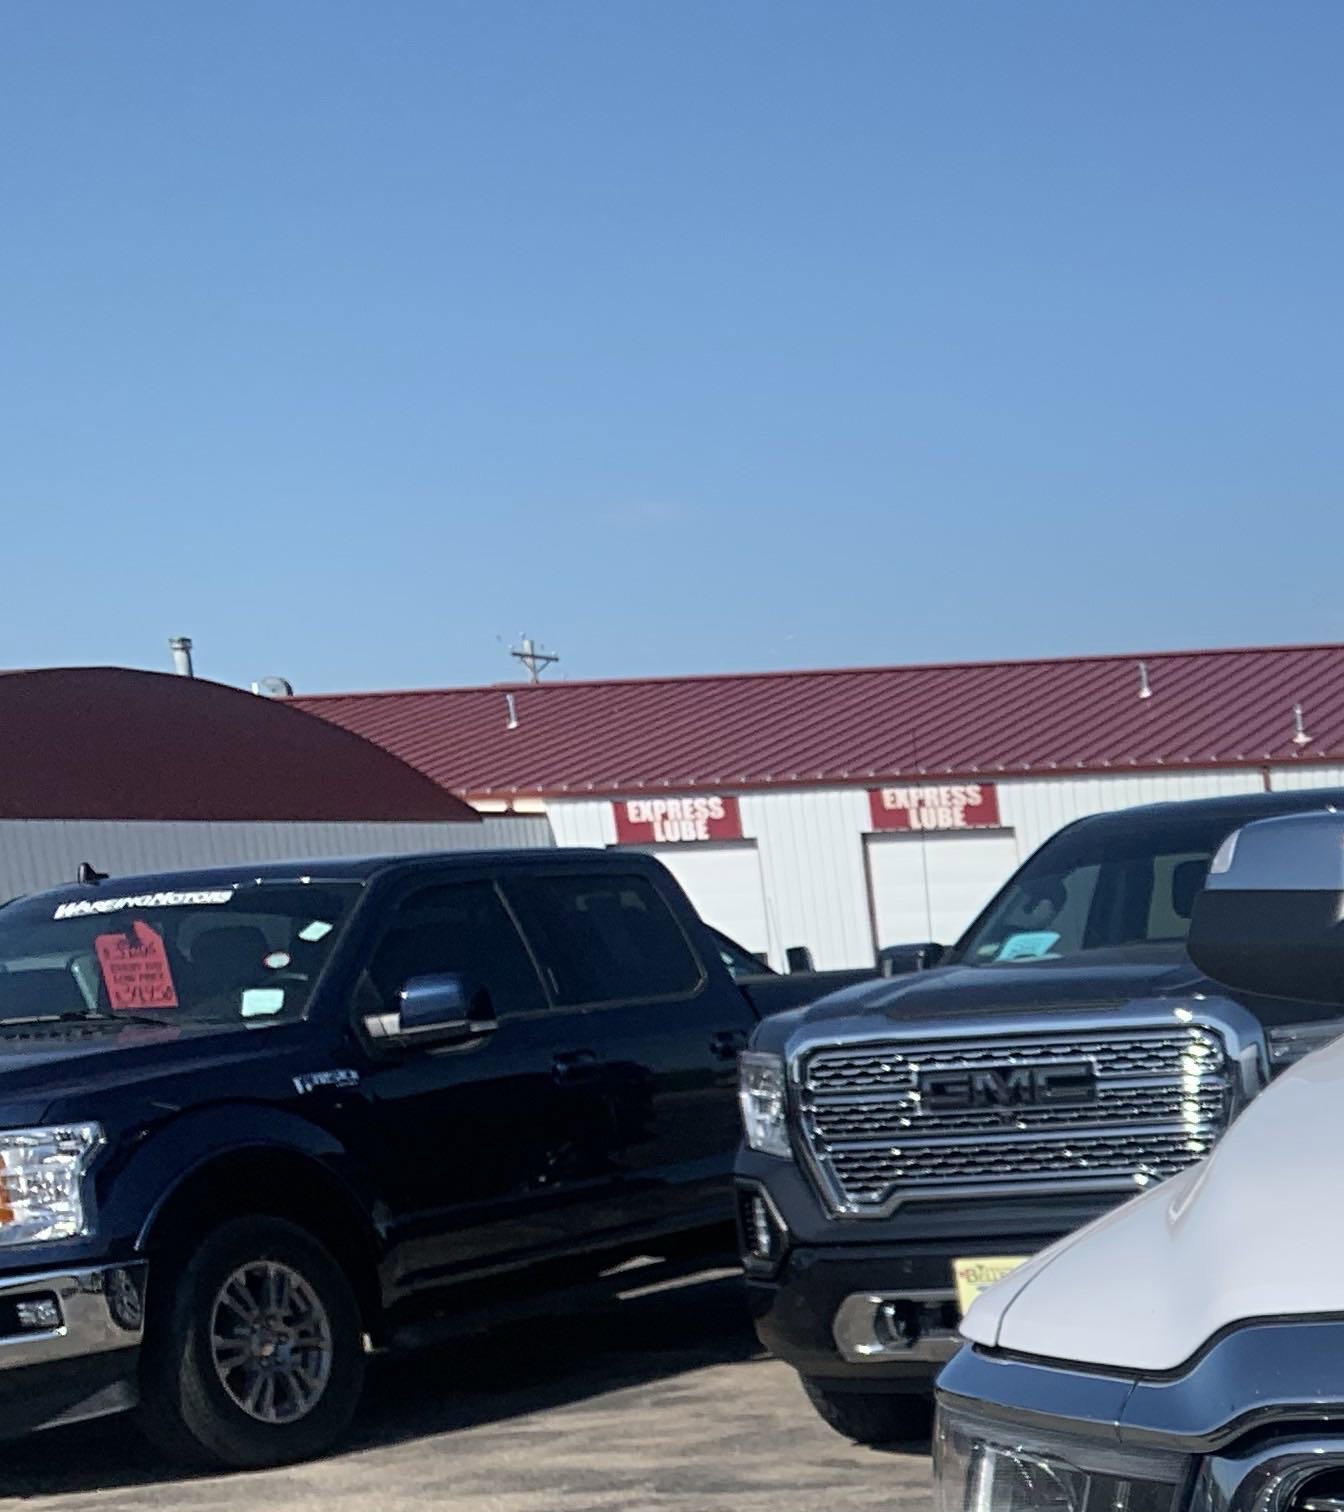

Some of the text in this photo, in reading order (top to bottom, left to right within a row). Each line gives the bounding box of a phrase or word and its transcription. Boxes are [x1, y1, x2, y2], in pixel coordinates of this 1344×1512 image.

[627, 796, 725, 824] EXPRESS
[882, 785, 983, 811] EXPRESS
[653, 819, 710, 842] LUBE
[908, 806, 967, 830] LUBE
[920, 1061, 1096, 1112] GMC
